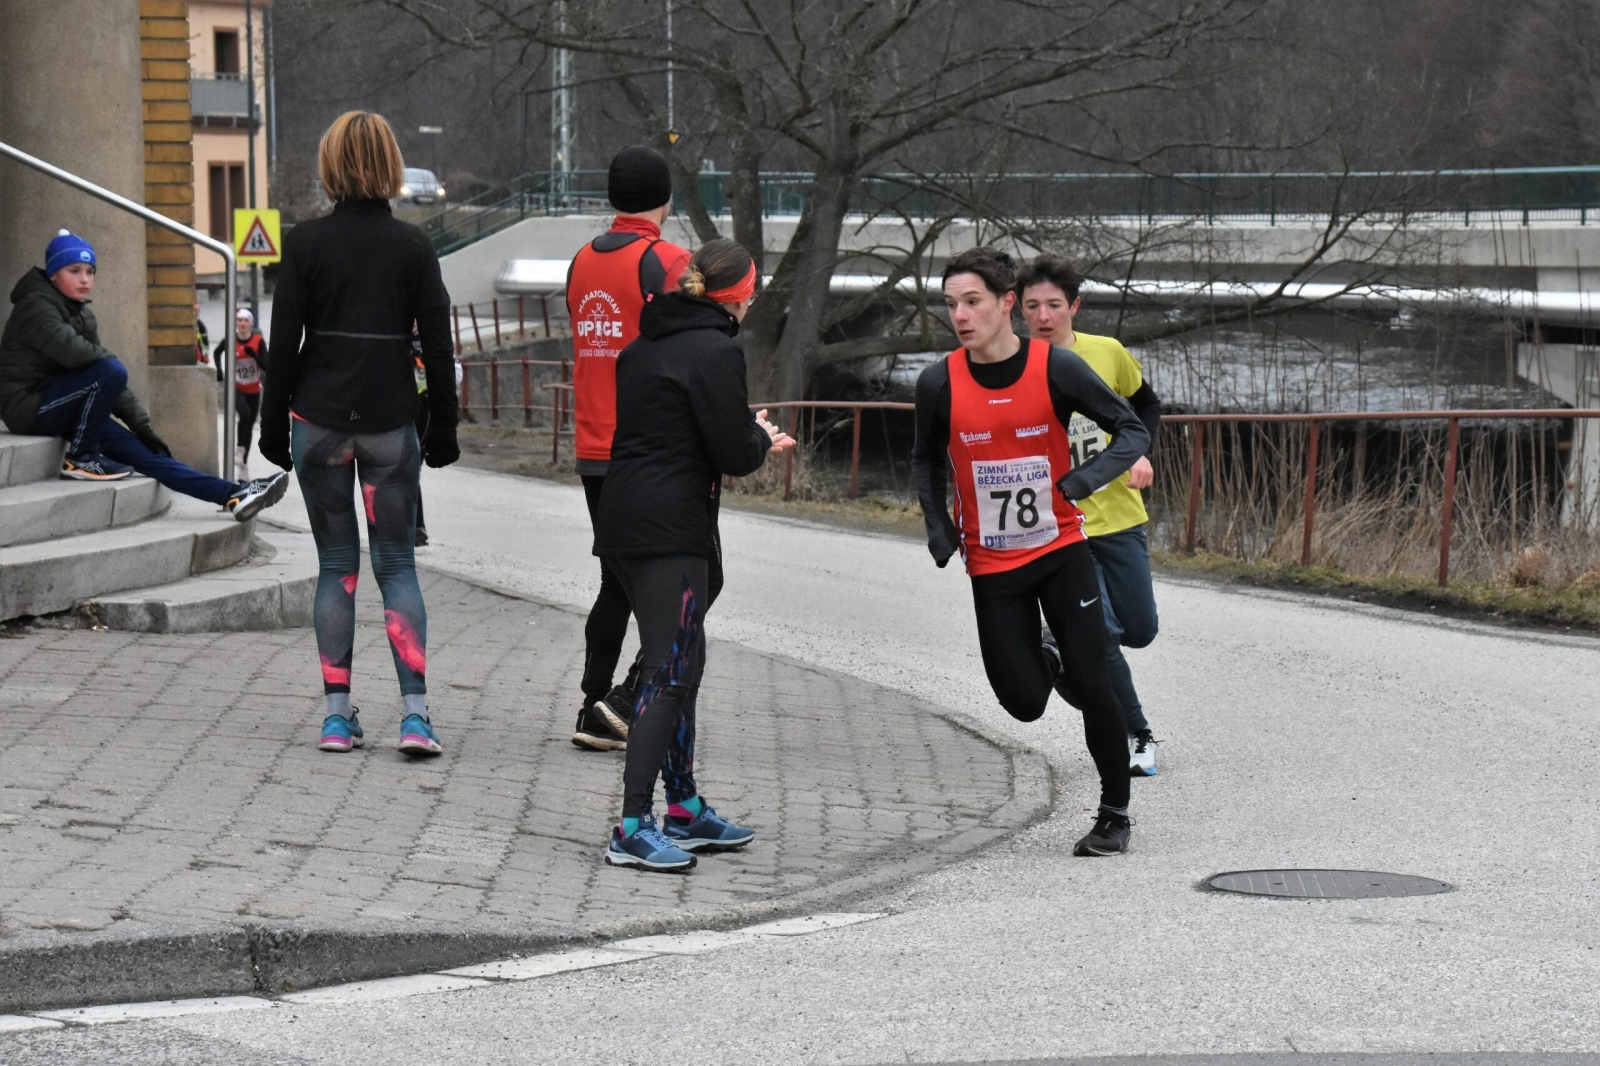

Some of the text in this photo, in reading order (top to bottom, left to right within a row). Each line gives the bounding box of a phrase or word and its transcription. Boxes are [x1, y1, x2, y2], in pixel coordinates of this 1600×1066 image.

[977, 463, 1008, 475] ZIMNÍ
[977, 473, 1023, 485] BĚŽECKÁ
[1026, 470, 1049, 482] LIGA
[990, 487, 1040, 531] 78
